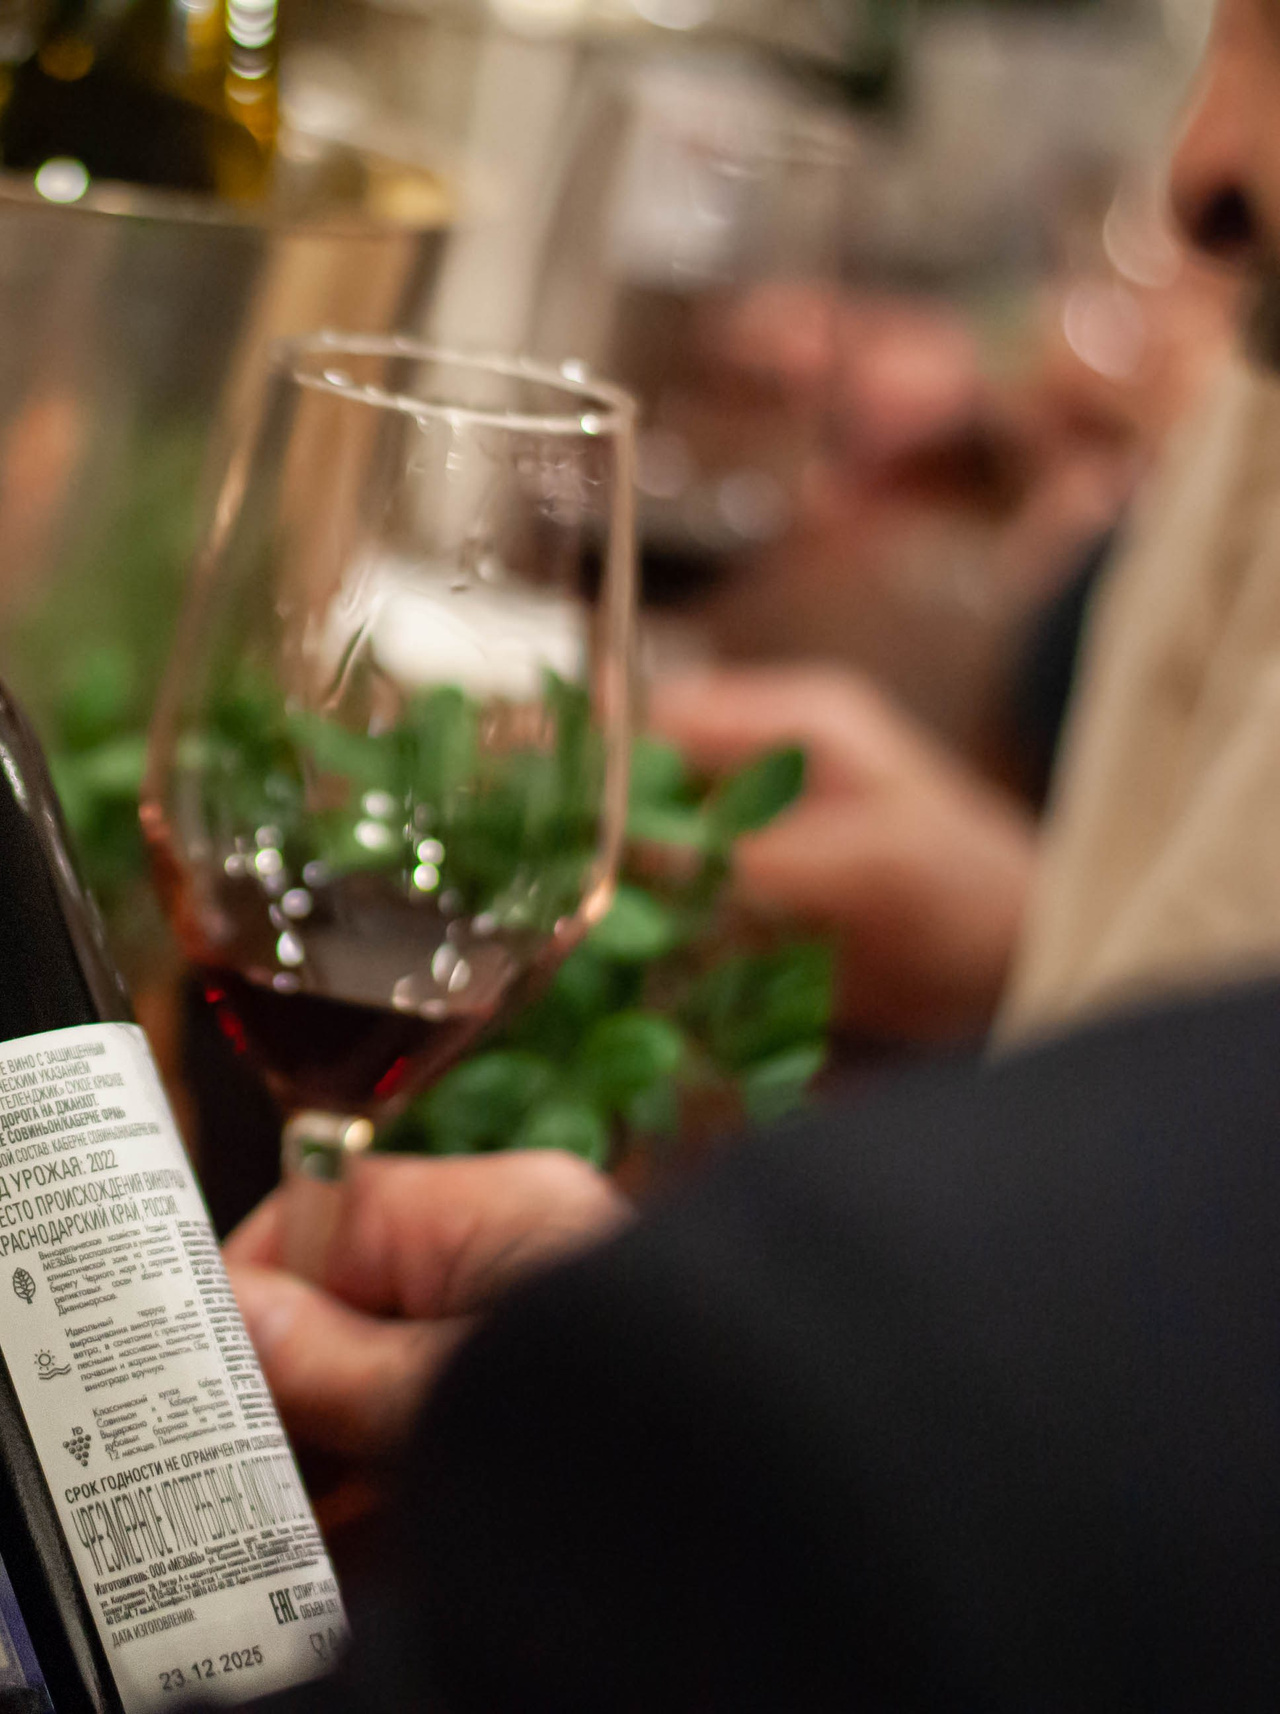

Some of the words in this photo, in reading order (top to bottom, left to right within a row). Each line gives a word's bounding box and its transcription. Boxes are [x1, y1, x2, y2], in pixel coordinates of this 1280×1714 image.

[8, 1057, 36, 1074] ВИНО
[37, 1054, 46, 1068] С
[38, 1062, 91, 1083] УКАЗАНИЕМ
[65, 1079, 93, 1096] СУХОЕ
[0, 1108, 40, 1129] ДОРОГА
[40, 1104, 55, 1118] НА
[8, 1112, 101, 1144] СОВИНЬОН/КАБЕРНЕ
[15, 1143, 53, 1164] СОСТАВ:
[52, 1135, 88, 1154] КАБЕРНЕ
[10, 1157, 87, 1193] УРОЖАЯ:
[86, 1150, 118, 1173] 2022
[35, 1174, 145, 1217] ПРОИСХОЖДЕНИЯ
[109, 1202, 145, 1227] КРАЙ,
[50, 1279, 79, 1294] берегу
[66, 1318, 114, 1338] Идеальный
[93, 1395, 148, 1417] Классический
[108, 1450, 121, 1461] 12
[65, 1481, 99, 1503] СРОК
[100, 1462, 164, 1492] ГОДНОСТИ
[165, 1457, 181, 1473] НЕ
[180, 1443, 236, 1469] ОГРАНИЧЕН
[235, 1439, 252, 1455] ПРИ
[70, 1487, 173, 1576] ЧРЕЗМЕРНОЕ
[149, 1563, 167, 1579] ООО
[112, 1627, 133, 1646] ДАТА
[158, 1646, 265, 1691] 23.12.2025
